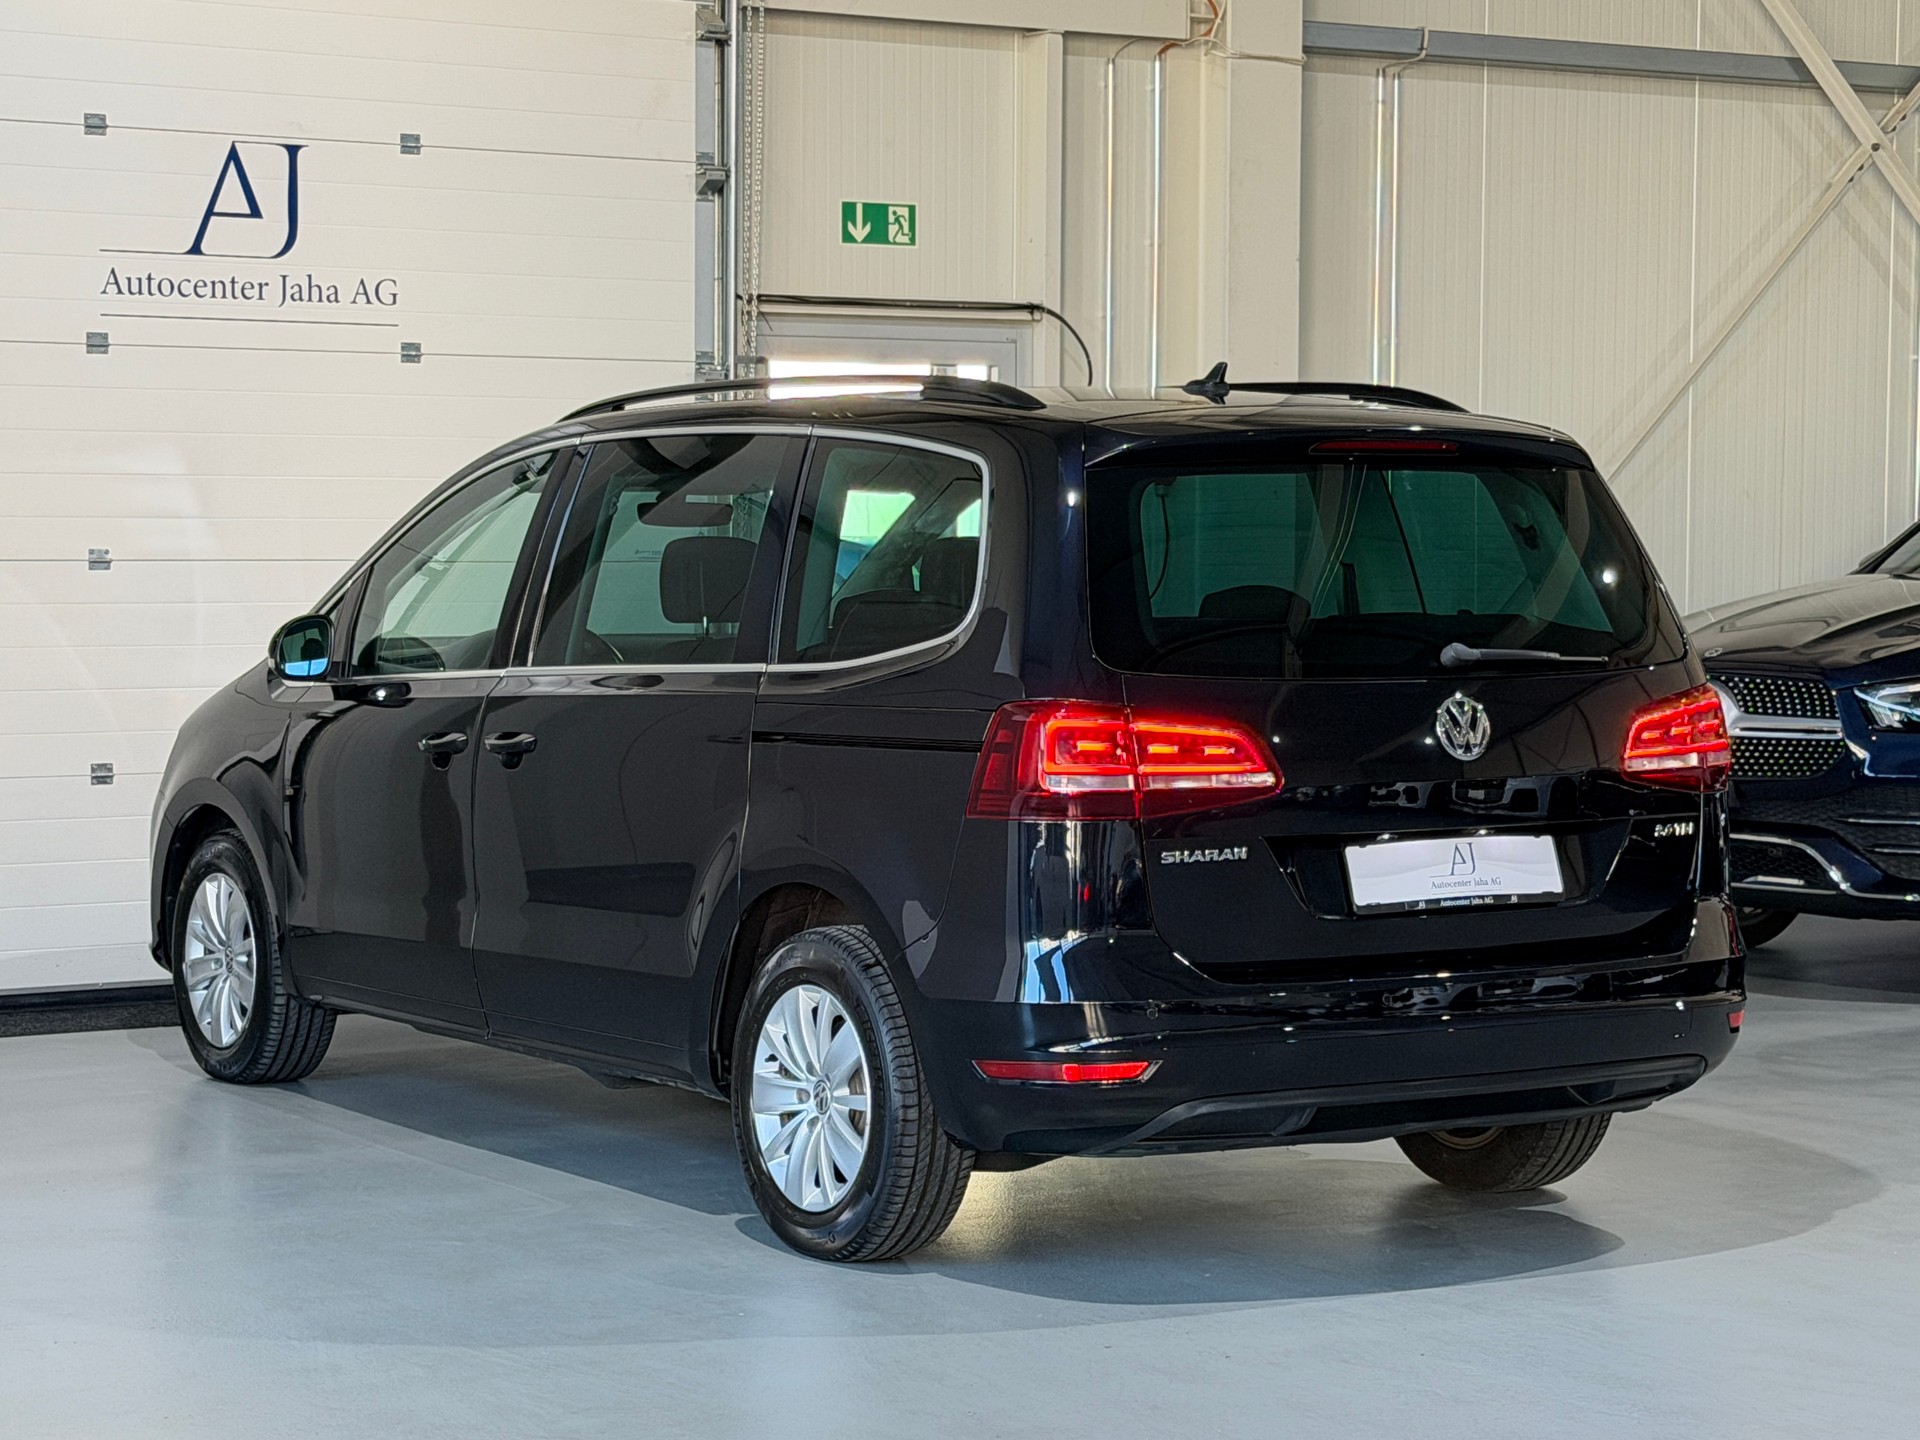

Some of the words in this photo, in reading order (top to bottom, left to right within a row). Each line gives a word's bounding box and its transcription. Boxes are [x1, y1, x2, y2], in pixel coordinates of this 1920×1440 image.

[181, 140, 310, 259] AJ
[100, 267, 270, 301] Autocenter
[278, 273, 341, 308] Jaha
[349, 277, 399, 307] AG
[1161, 846, 1248, 864] SHARAN
[1449, 842, 1476, 876] AJ
[1430, 879, 1472, 890] Autocenter
[1474, 877, 1489, 888] Jaha
[1490, 876, 1502, 886] AG
[1440, 899, 1471, 907] Autocenter
[1471, 897, 1484, 906] Jaha
[1484, 896, 1494, 904] AG
